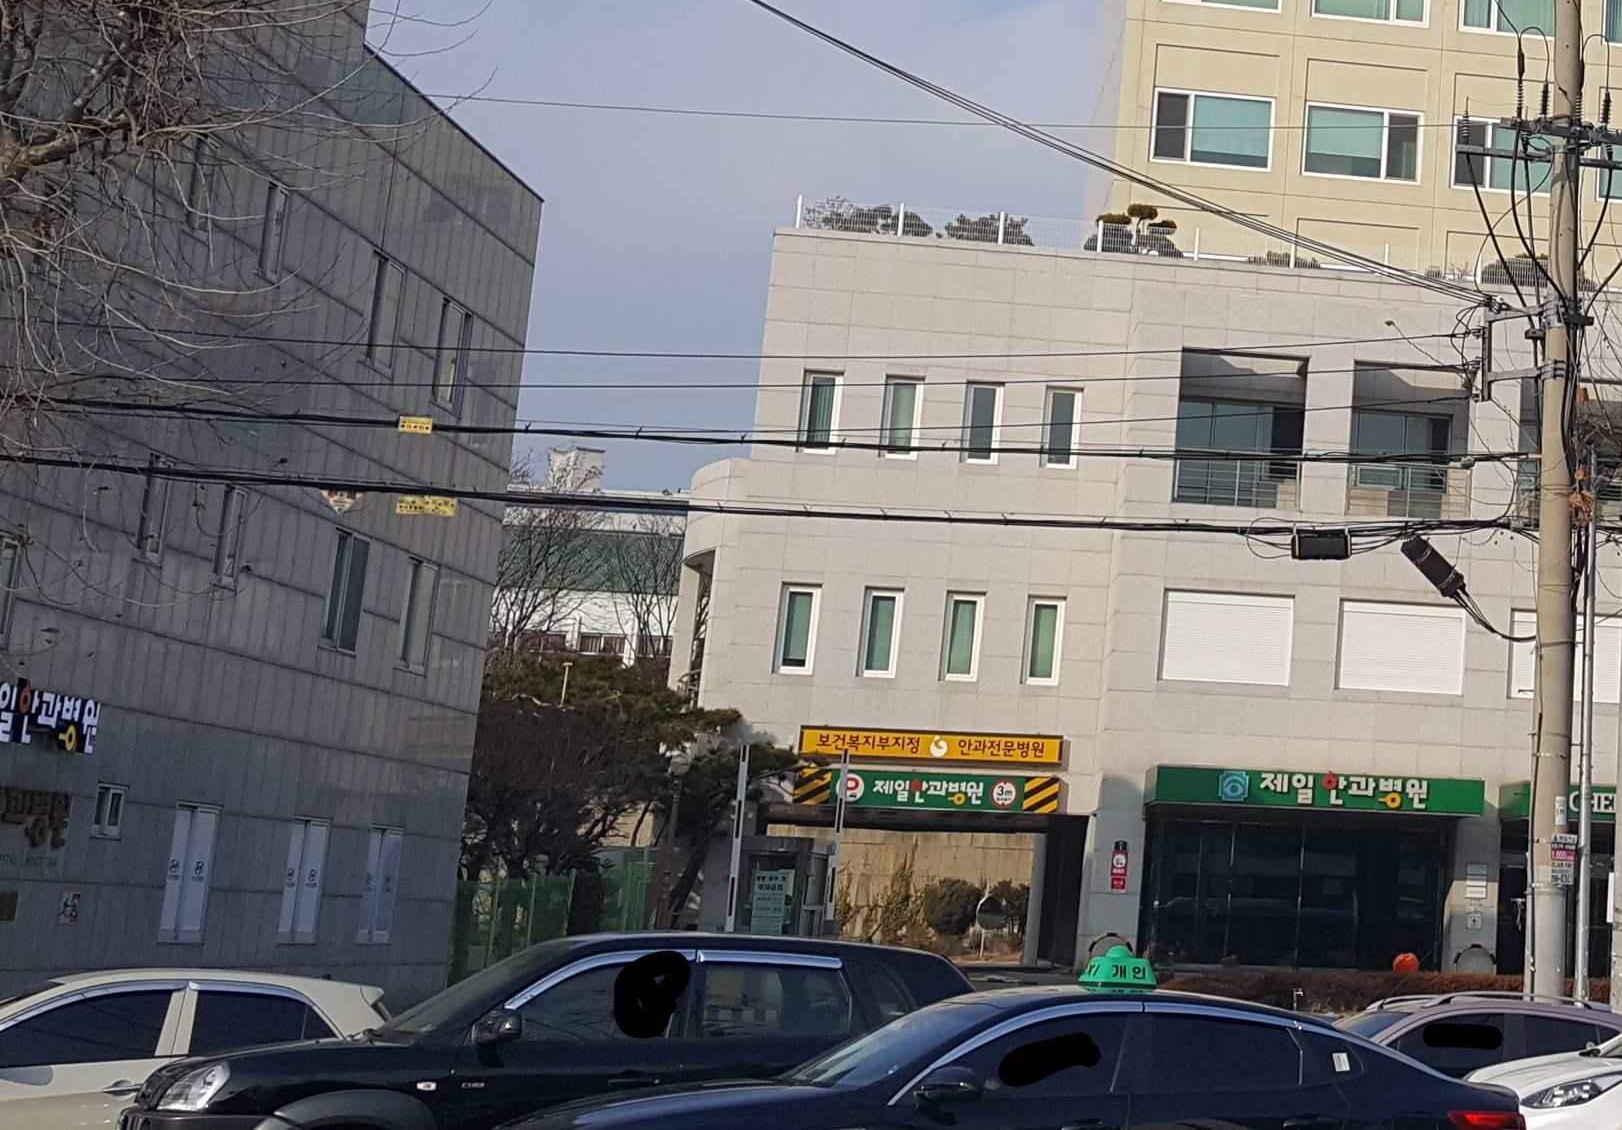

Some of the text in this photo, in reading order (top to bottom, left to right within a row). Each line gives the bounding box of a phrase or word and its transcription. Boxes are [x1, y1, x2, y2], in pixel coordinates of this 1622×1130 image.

[815, 733, 1046, 759] 보건복지부지정 안과전문병원
[872, 778, 984, 805] 제일안과병원
[997, 785, 1013, 796] 3m
[1259, 771, 1428, 810] 제일안과병원
[1569, 790, 1617, 813] CHE
[1111, 964, 1147, 980] 개인
